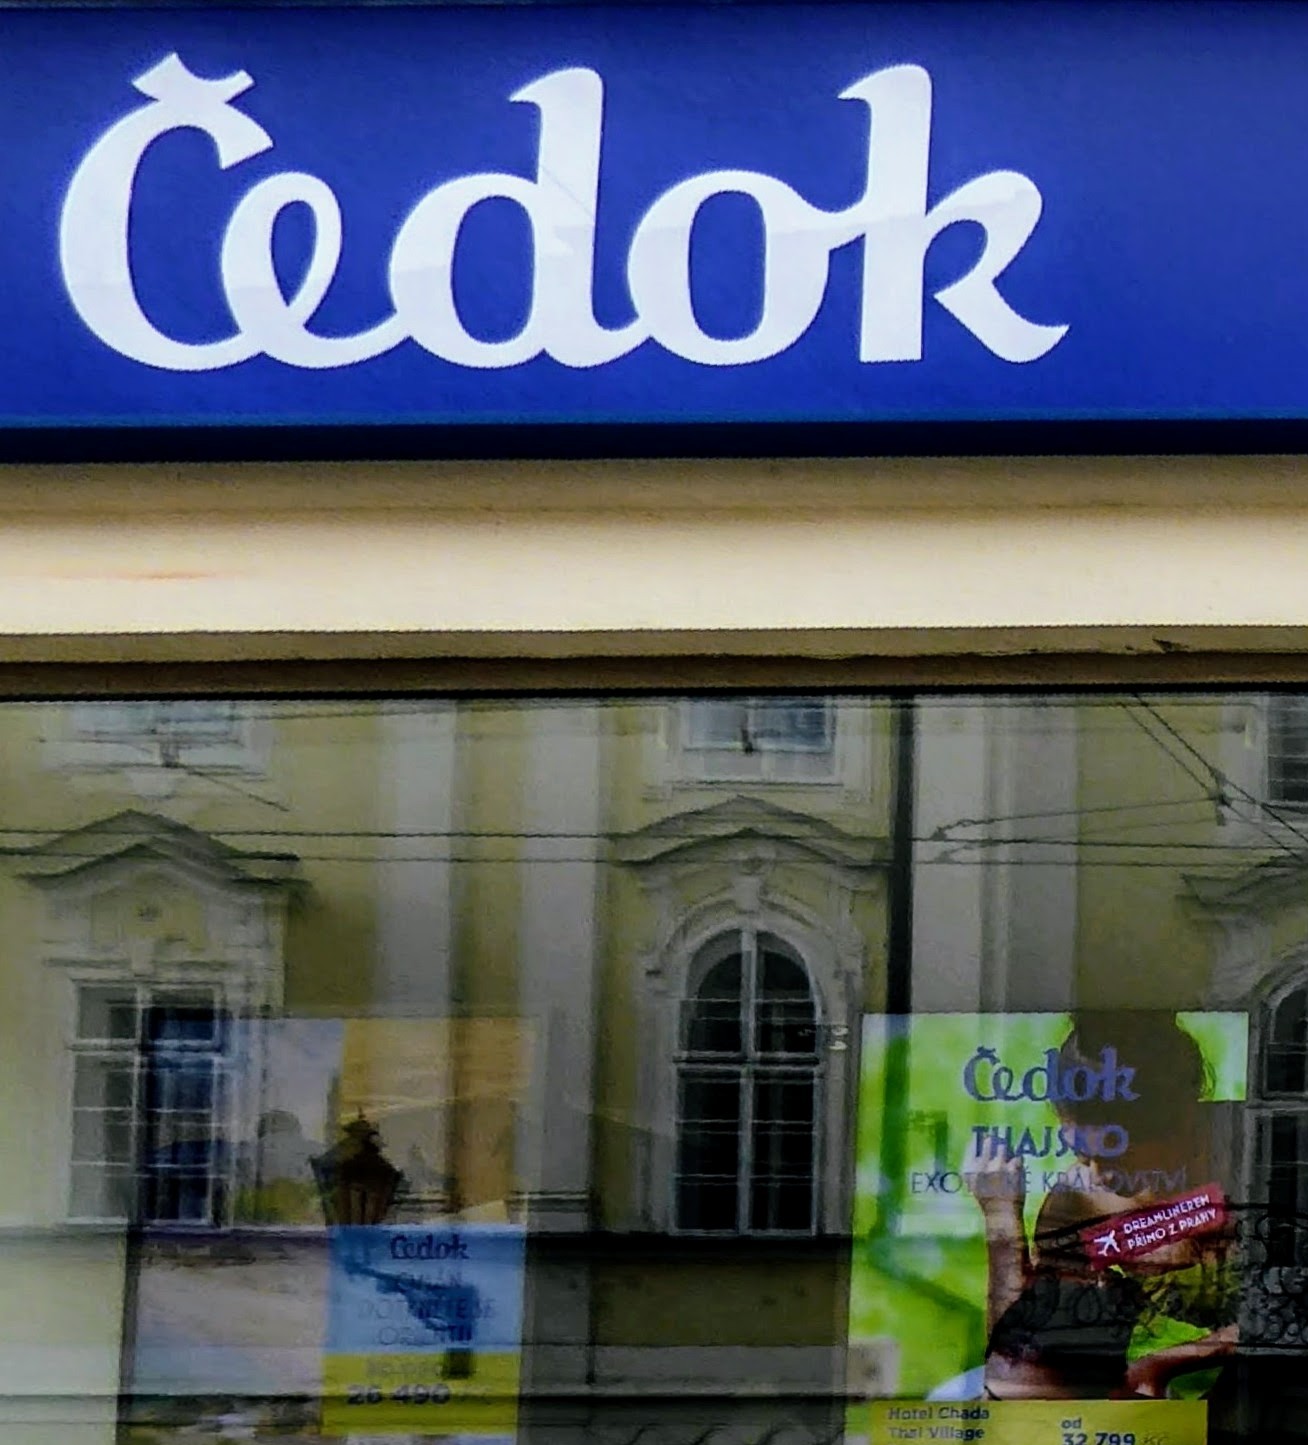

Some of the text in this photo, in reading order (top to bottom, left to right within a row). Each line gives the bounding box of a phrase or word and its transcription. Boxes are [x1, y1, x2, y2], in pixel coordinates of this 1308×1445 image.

[58, 51, 1071, 372] Čedok
[963, 1046, 1141, 1102] Čedok
[971, 1124, 1129, 1159] THAJSKO
[1168, 1224, 1179, 1236] Z
[1179, 1208, 1216, 1232] PRAHY
[888, 1407, 990, 1420] Hotel Chada
[1061, 1418, 1082, 1429] od
[929, 1426, 985, 1441] Village
